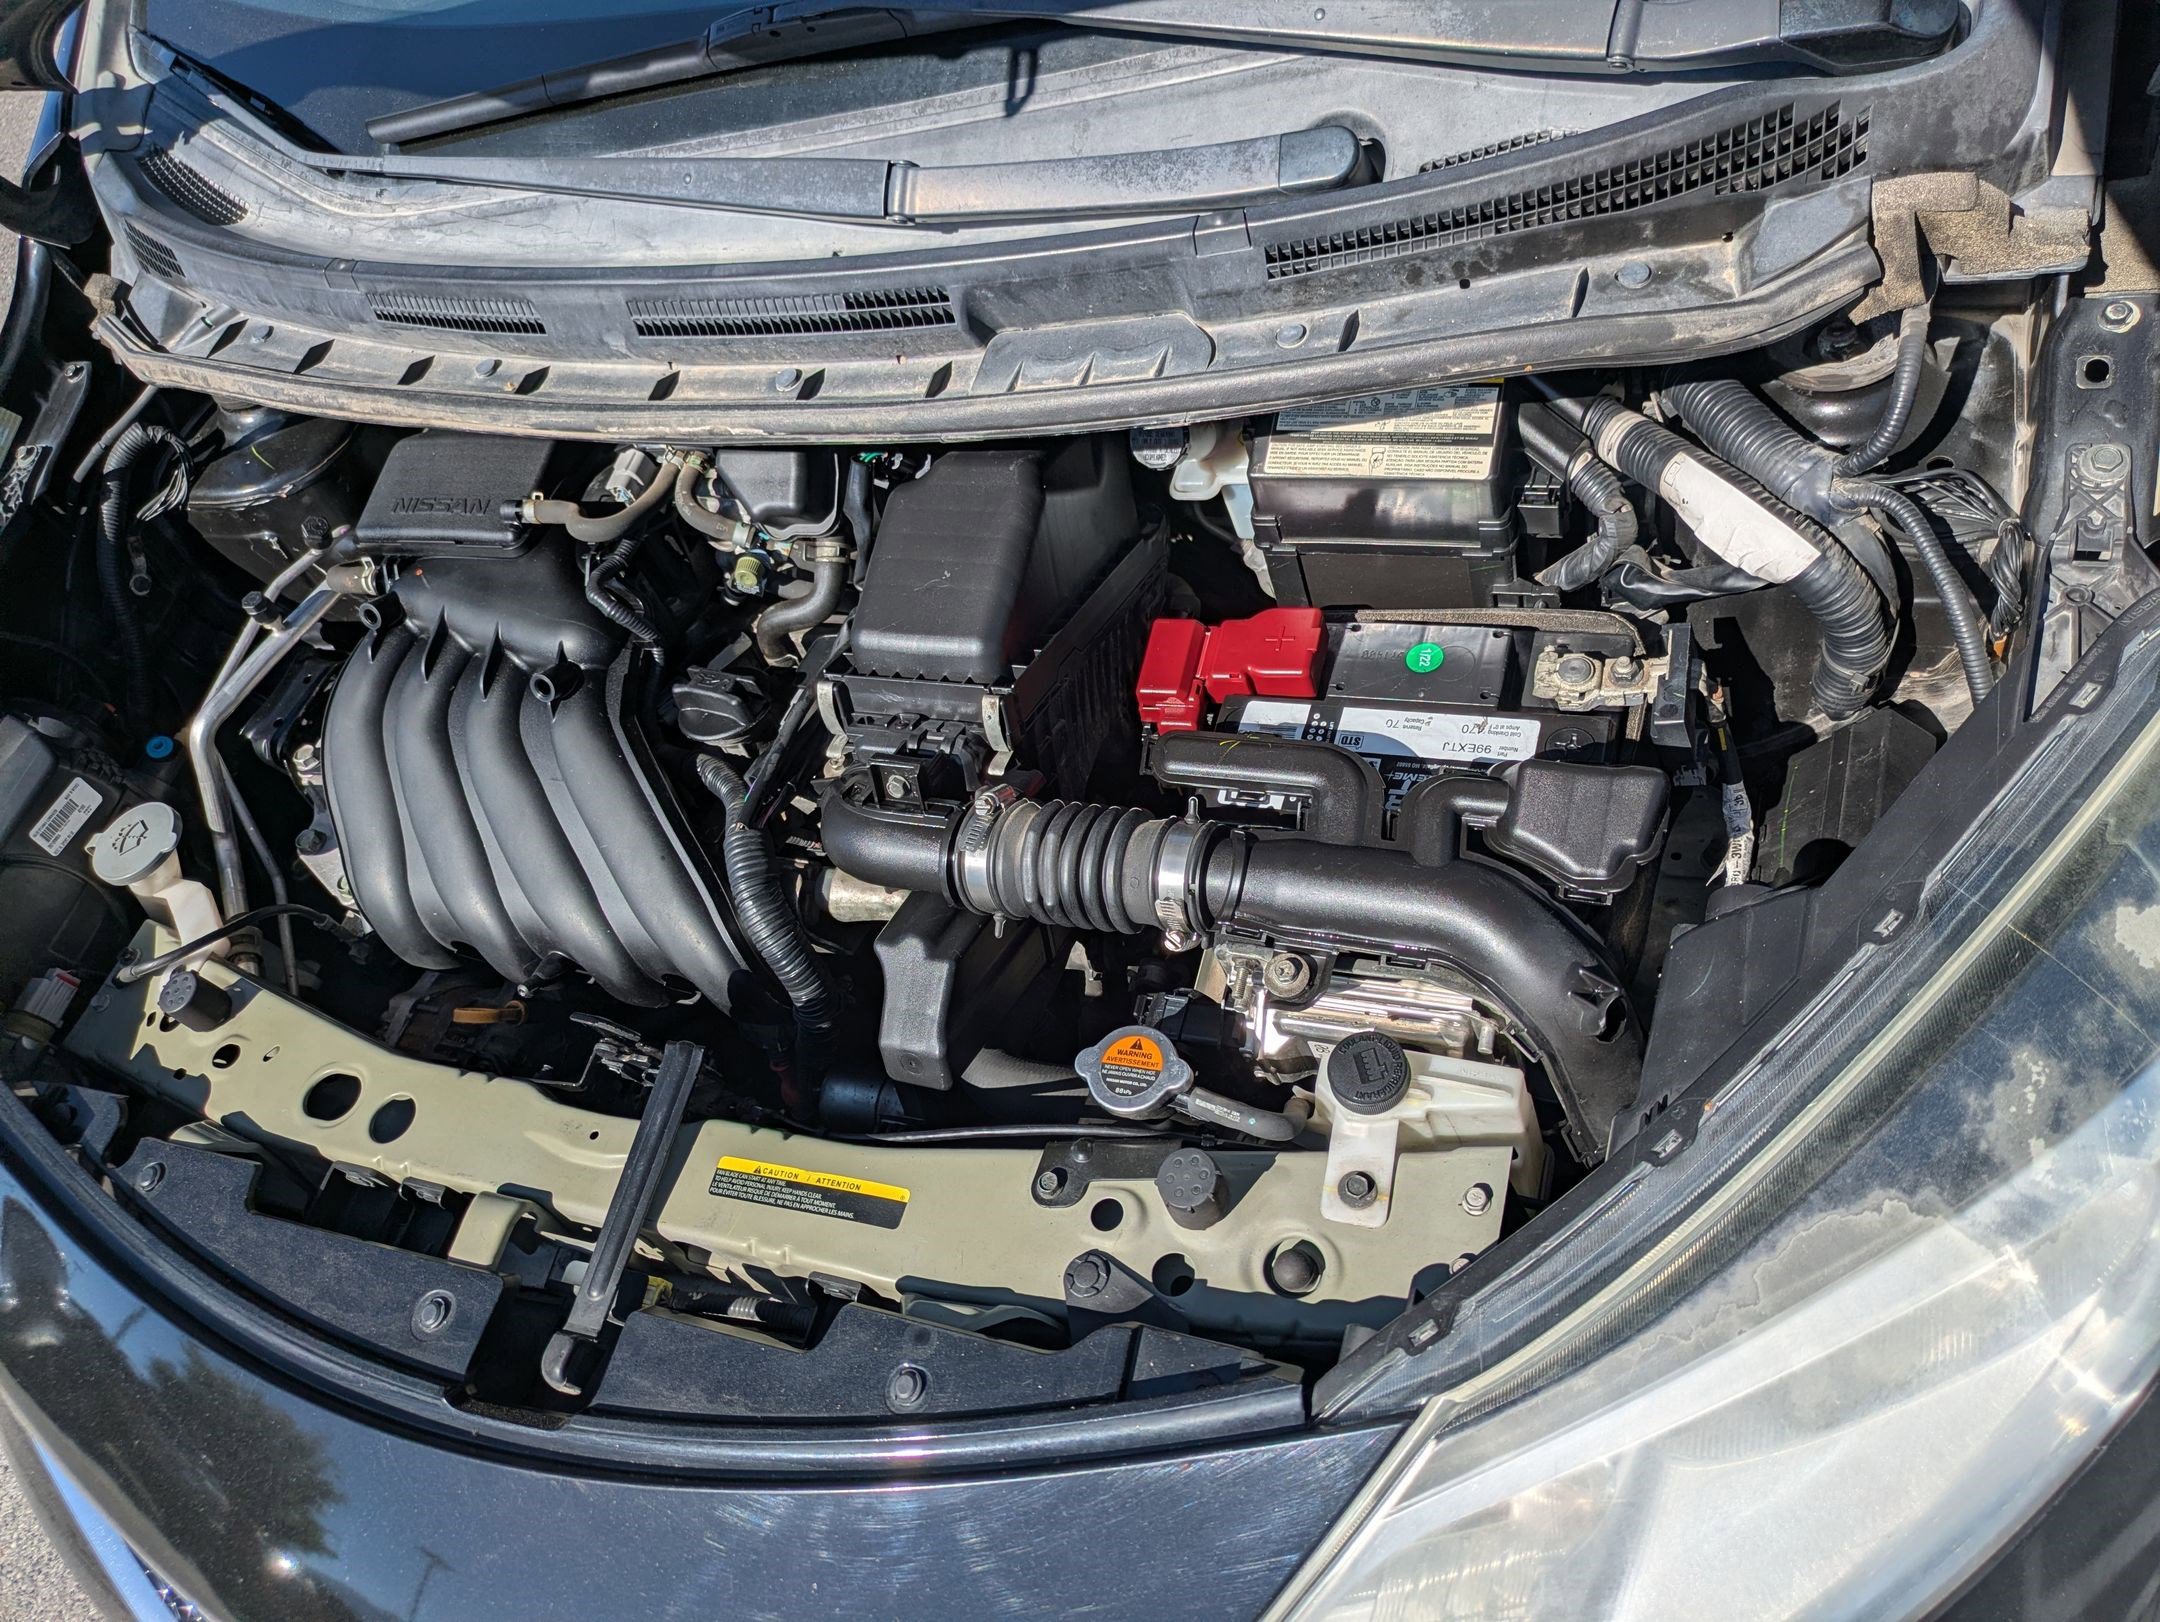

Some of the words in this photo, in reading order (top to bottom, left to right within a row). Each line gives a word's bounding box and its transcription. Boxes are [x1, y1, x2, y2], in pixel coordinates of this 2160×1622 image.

[391, 497, 491, 515] NISSAN
[1418, 648, 1433, 667] 1/22
[1385, 718, 1400, 729] 70
[1404, 716, 1425, 725] Capacity
[1487, 729, 1509, 737] Cranking
[1340, 735, 1361, 746] STD
[1442, 741, 1492, 754] 99EXTJ
[1498, 745, 1519, 753] Number
[1117, 1048, 1153, 1060] WARNING
[1106, 1055, 1160, 1068] AVERTISSEMENT
[762, 1168, 799, 1180] CAUTION
[815, 1177, 861, 1191] ATTENTION
[718, 1182, 747, 1192] VENTILATEUR
[746, 1187, 764, 1195] RISQUE
[800, 1197, 813, 1205] TOUT
[744, 1180, 766, 1189] PERSONAL
[791, 1189, 808, 1197] HANDS
[737, 1192, 753, 1200] TOUTE
[799, 1204, 828, 1214] APPROCHER
